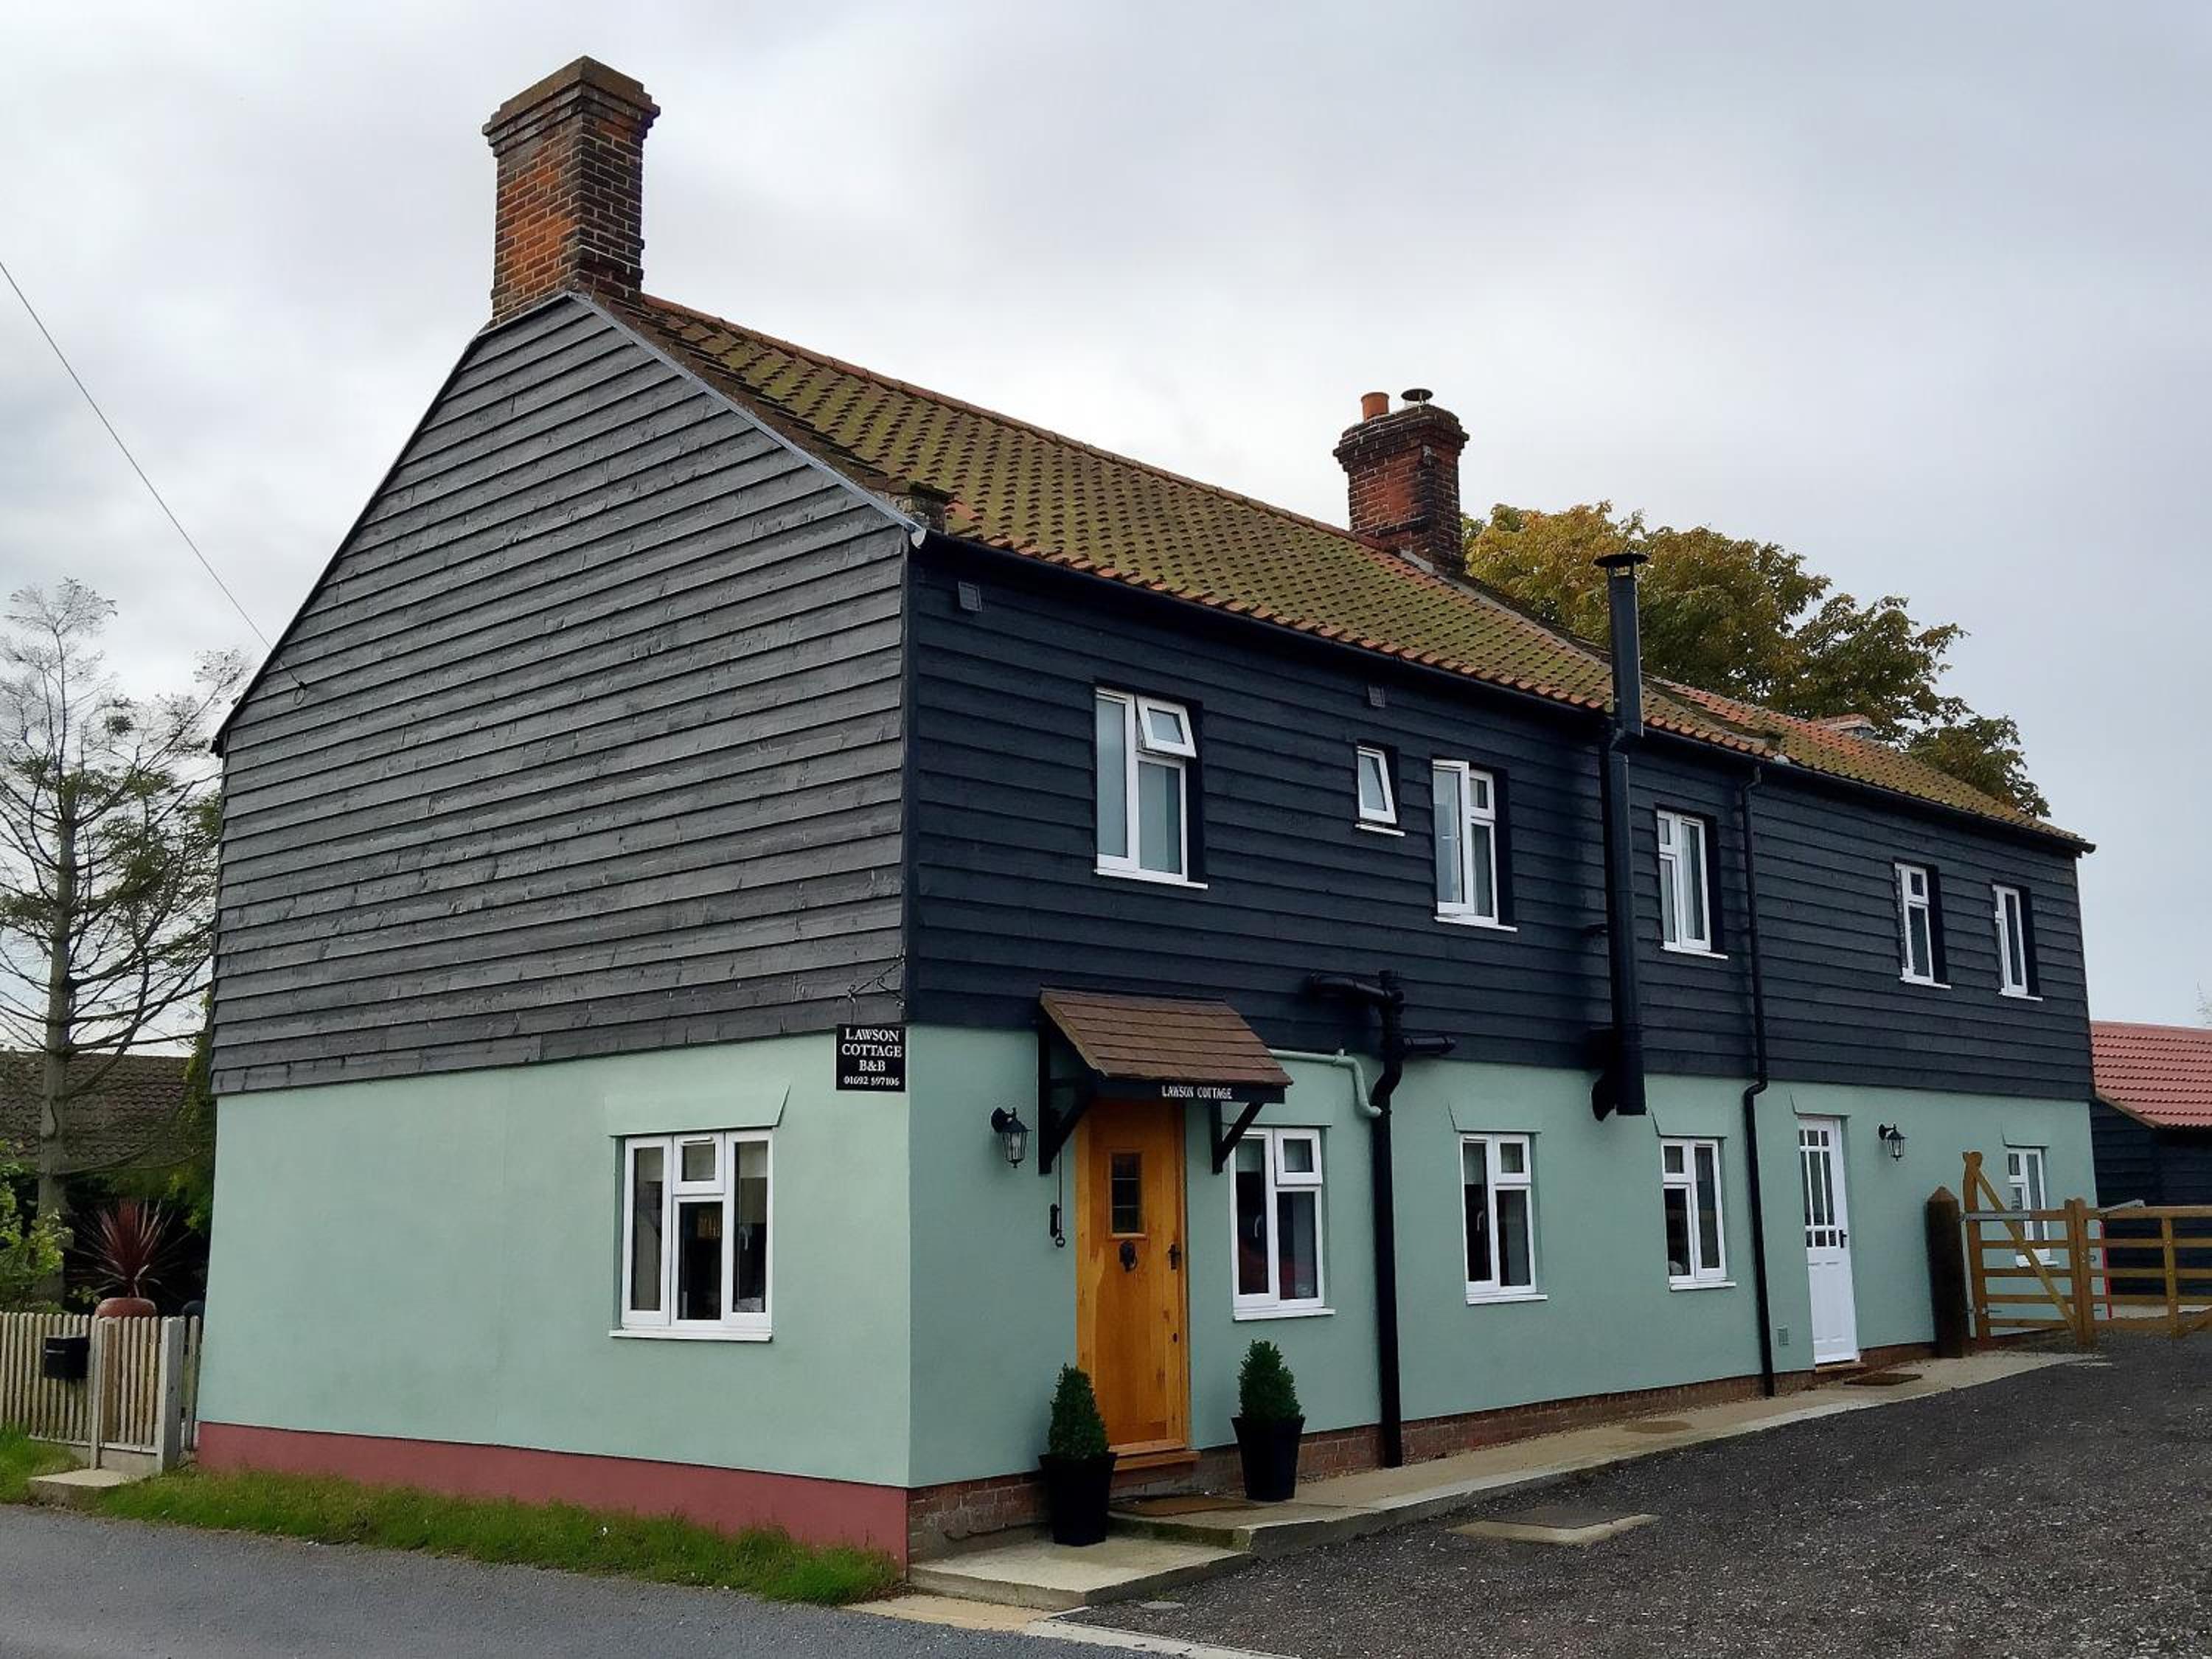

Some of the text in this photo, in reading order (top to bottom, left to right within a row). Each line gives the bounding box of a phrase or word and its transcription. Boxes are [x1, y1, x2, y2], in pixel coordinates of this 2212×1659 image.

[844, 1027, 899, 1041] LAWSON
[841, 1043, 902, 1057] COTTAGE
[858, 1060, 886, 1071] B&B
[844, 1076, 869, 1085] 01692
[1161, 1085, 1232, 1099] LAWSON COTTAGE
